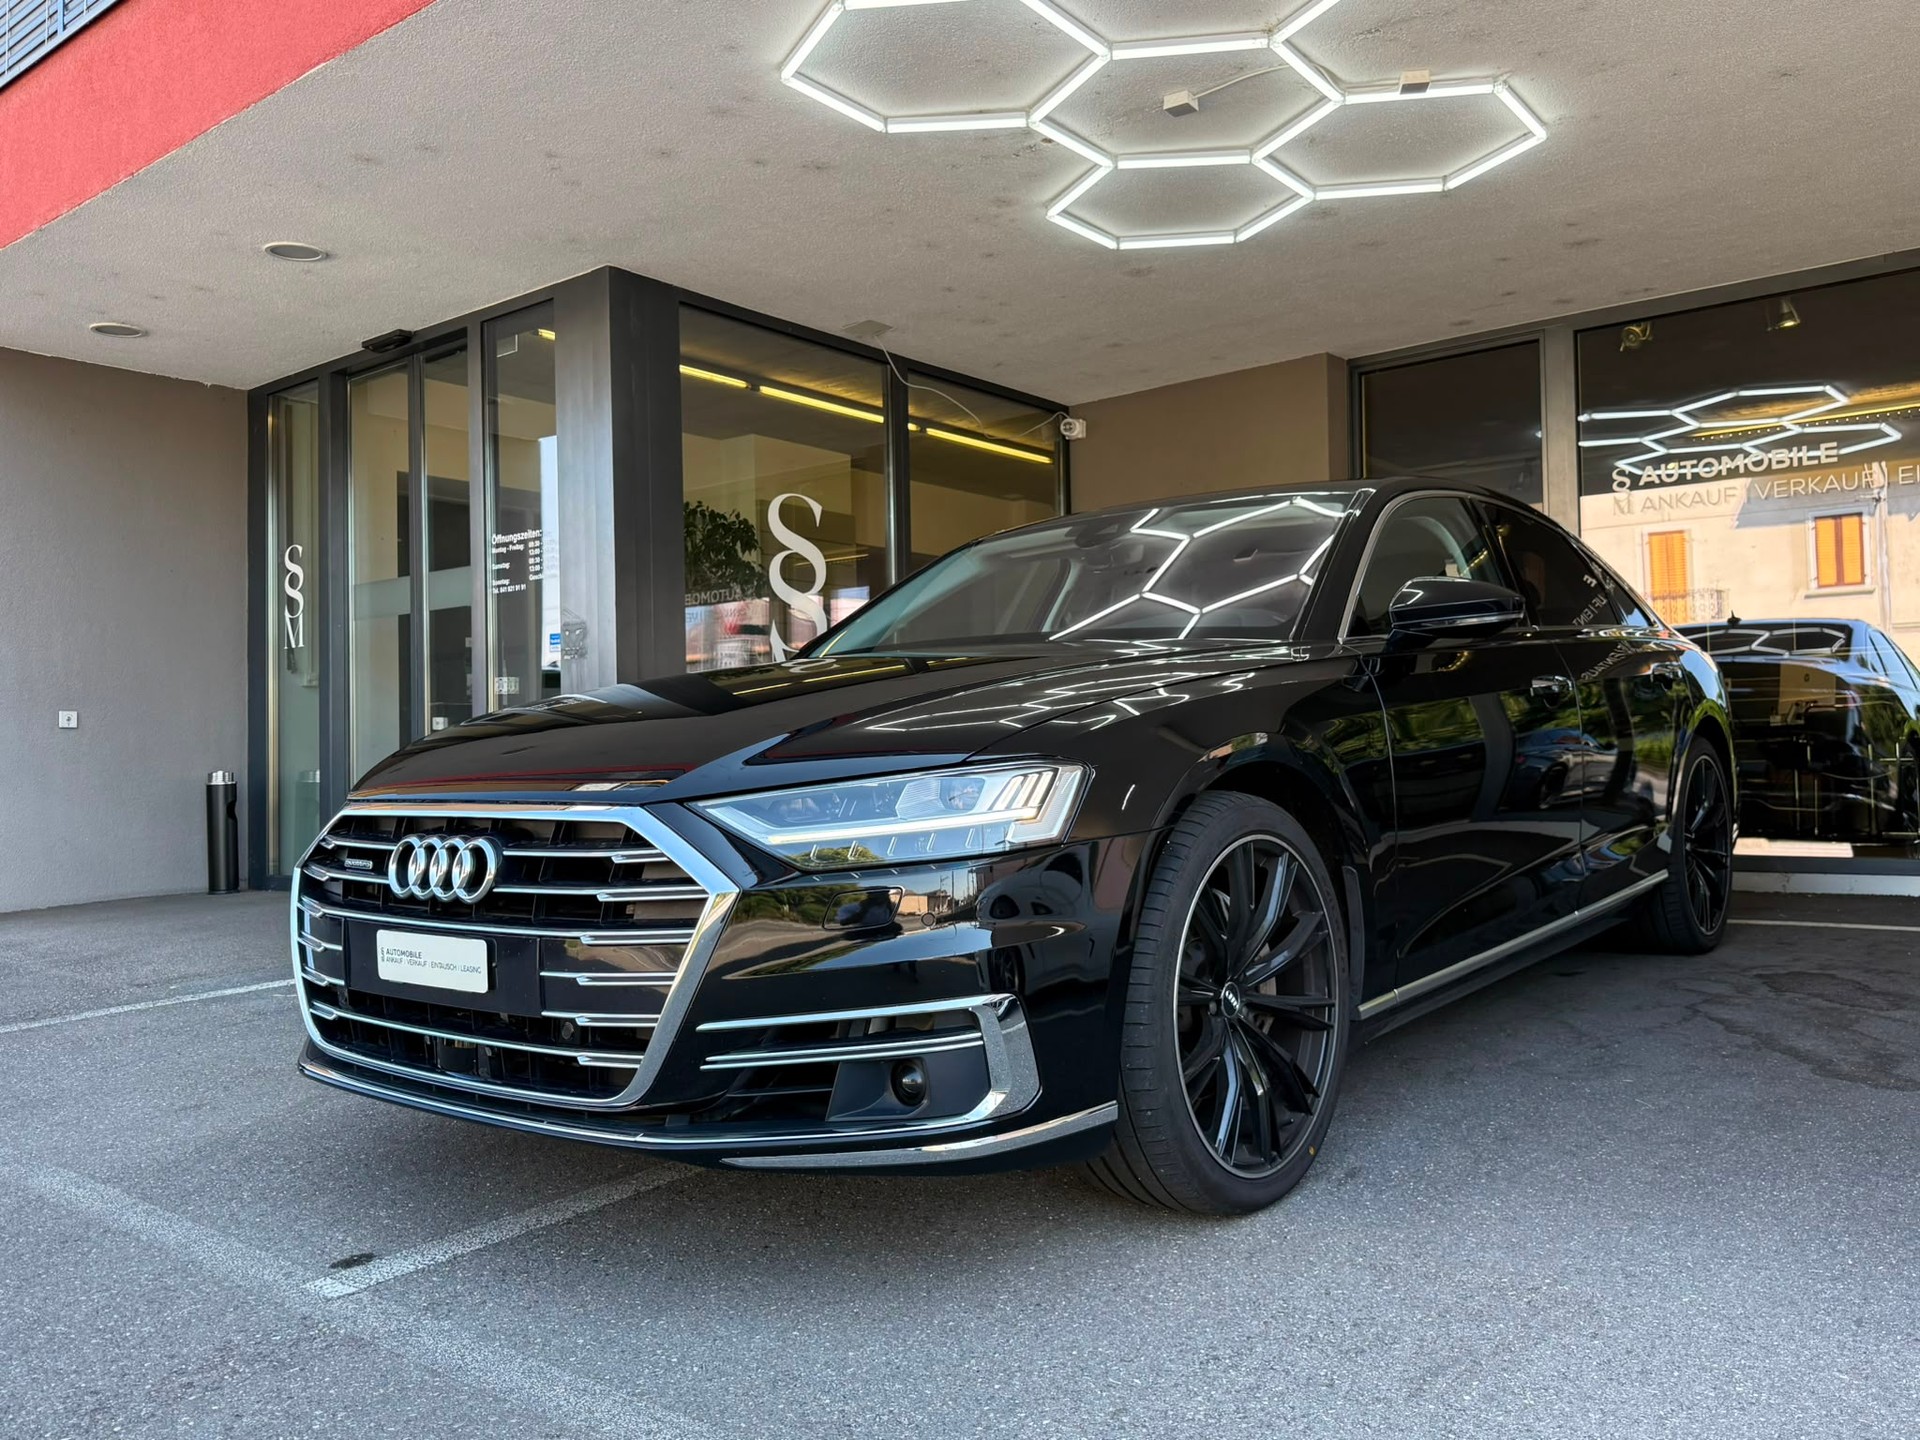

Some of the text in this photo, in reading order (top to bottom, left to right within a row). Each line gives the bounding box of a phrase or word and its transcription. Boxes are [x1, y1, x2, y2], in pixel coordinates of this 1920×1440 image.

[1637, 441, 1839, 486] AUTOMOBILE
[1640, 486, 1738, 513] ANKAUF
[1754, 469, 1877, 500] VERKAUF
[386, 948, 422, 959] AUTOMOBILE
